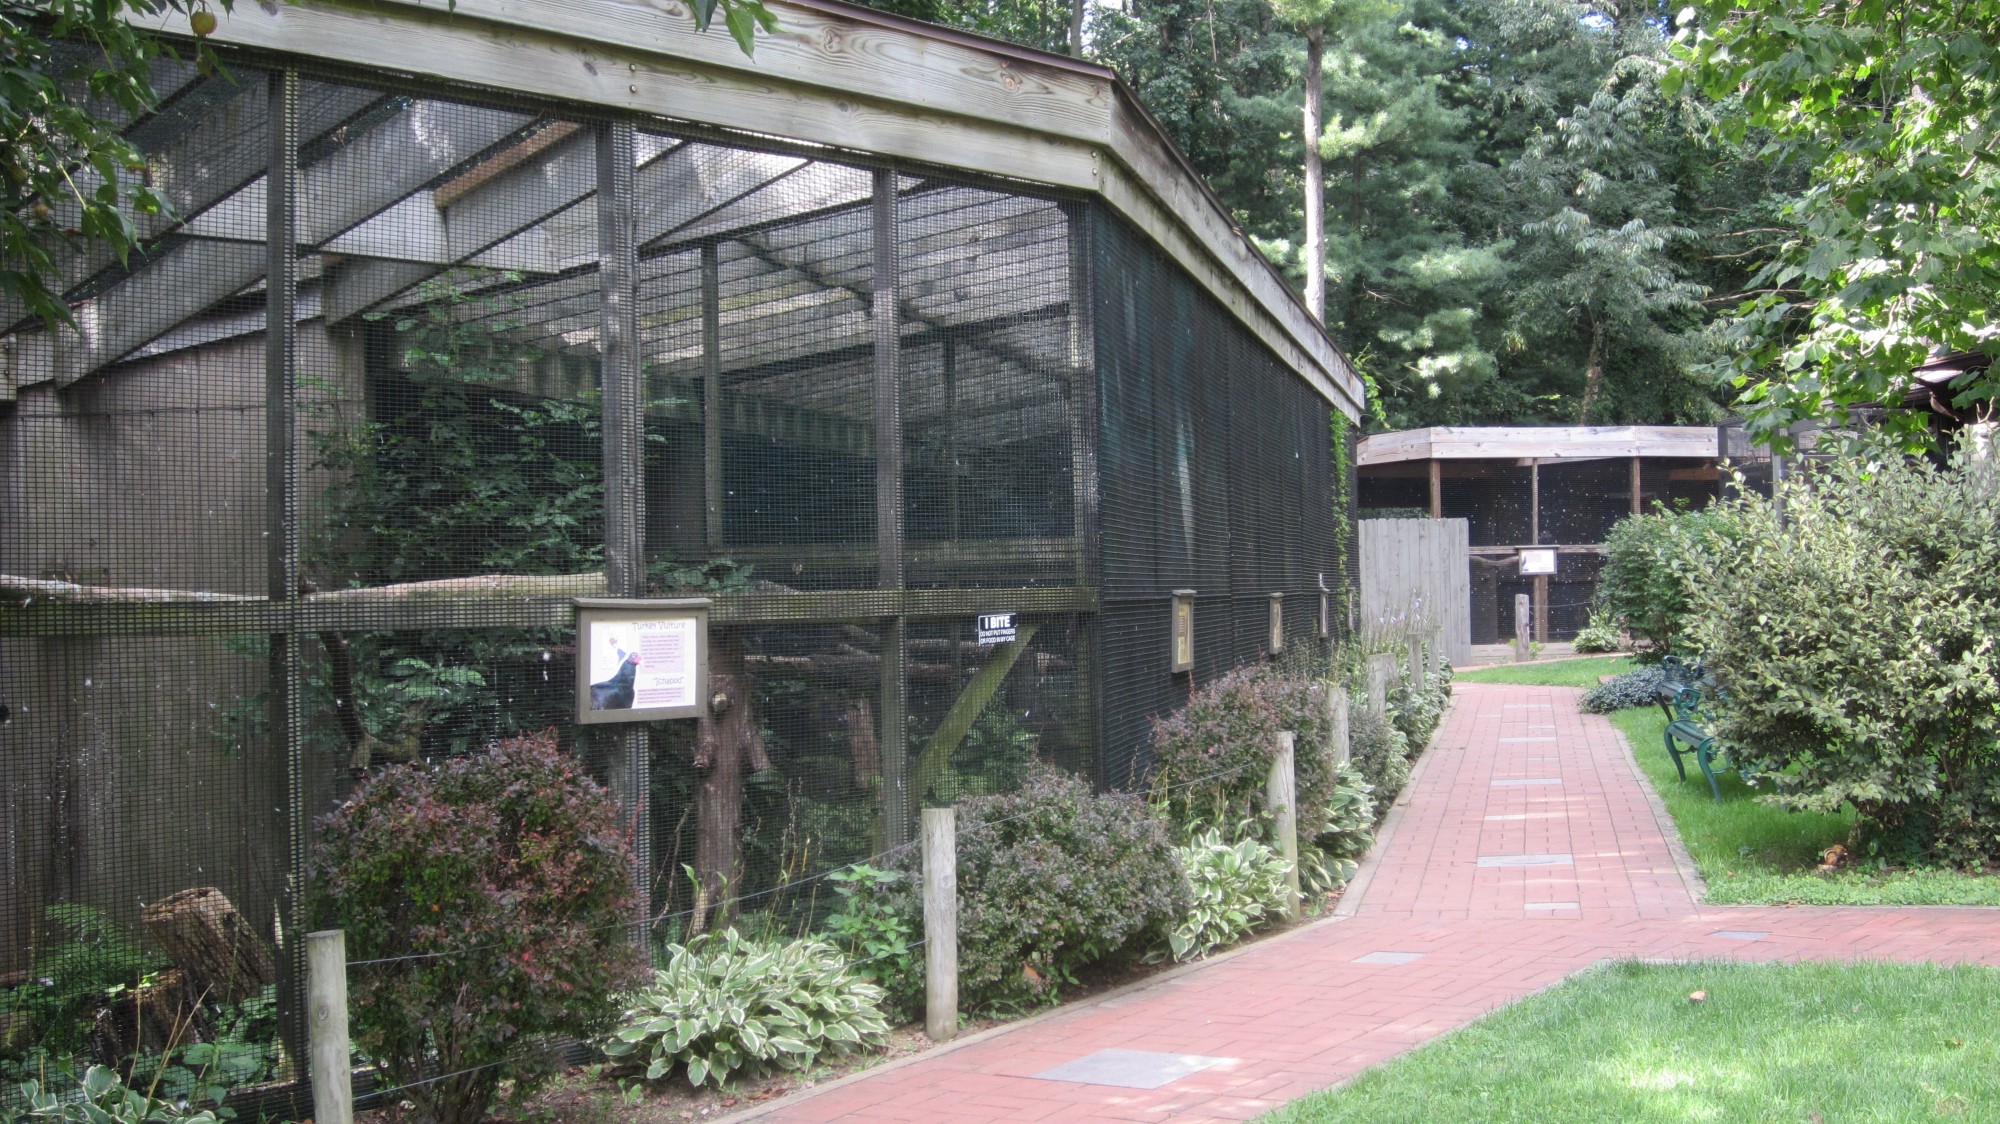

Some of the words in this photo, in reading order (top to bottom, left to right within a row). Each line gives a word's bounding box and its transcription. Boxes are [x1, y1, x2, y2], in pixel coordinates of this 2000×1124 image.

[632, 622, 656, 631] Turkey
[658, 621, 686, 630] Vulture
[990, 616, 1010, 629] BITE
